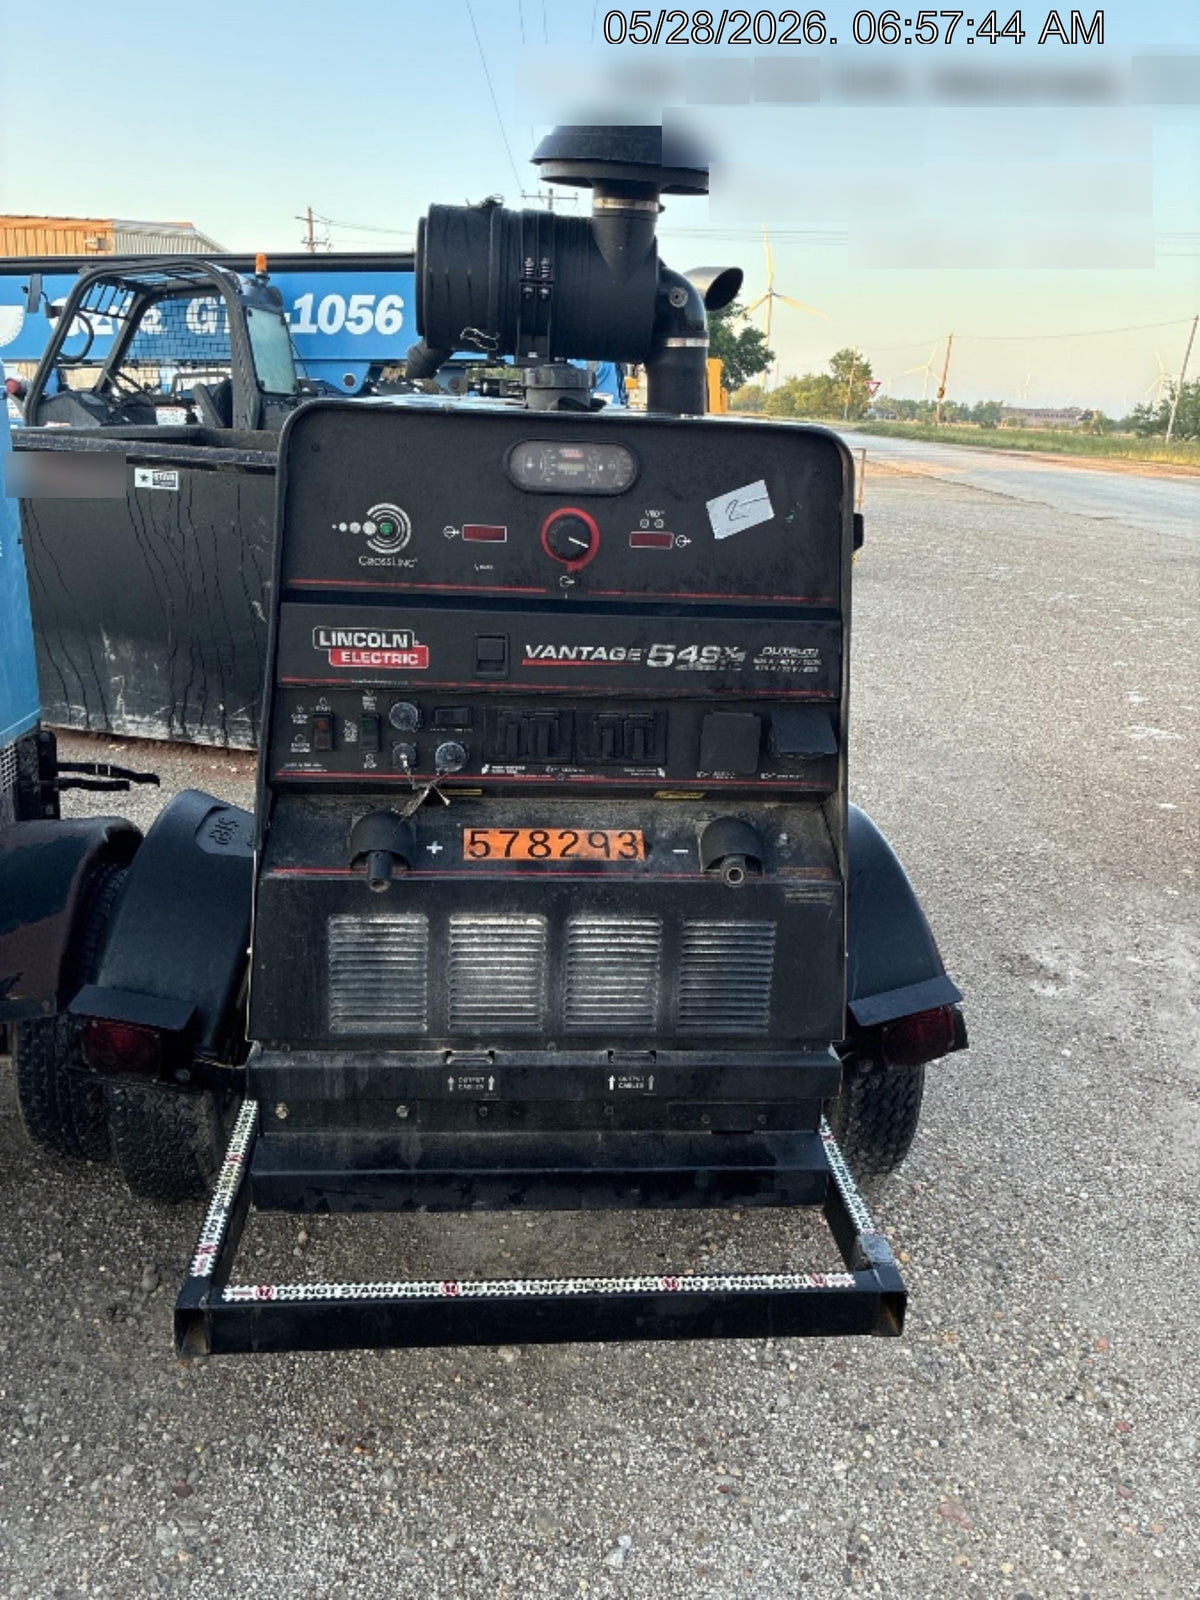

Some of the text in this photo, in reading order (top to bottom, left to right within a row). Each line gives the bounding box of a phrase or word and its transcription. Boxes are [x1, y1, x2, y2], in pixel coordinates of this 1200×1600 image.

[186, 293, 404, 336] G-1056
[319, 630, 409, 648] LINCOLN
[340, 651, 419, 665] ELECTRIC
[525, 644, 641, 661] VANTAGE
[468, 829, 640, 860] 578293
[276, 1288, 301, 1296] DO
[304, 1287, 336, 1296] NOT
[341, 1285, 394, 1295] STAND
[398, 1285, 440, 1294] HERE
[462, 1284, 483, 1292] NE
[487, 1284, 516, 1292] PAS
[639, 1280, 659, 1288] ICI
[681, 1280, 703, 1288] NO
